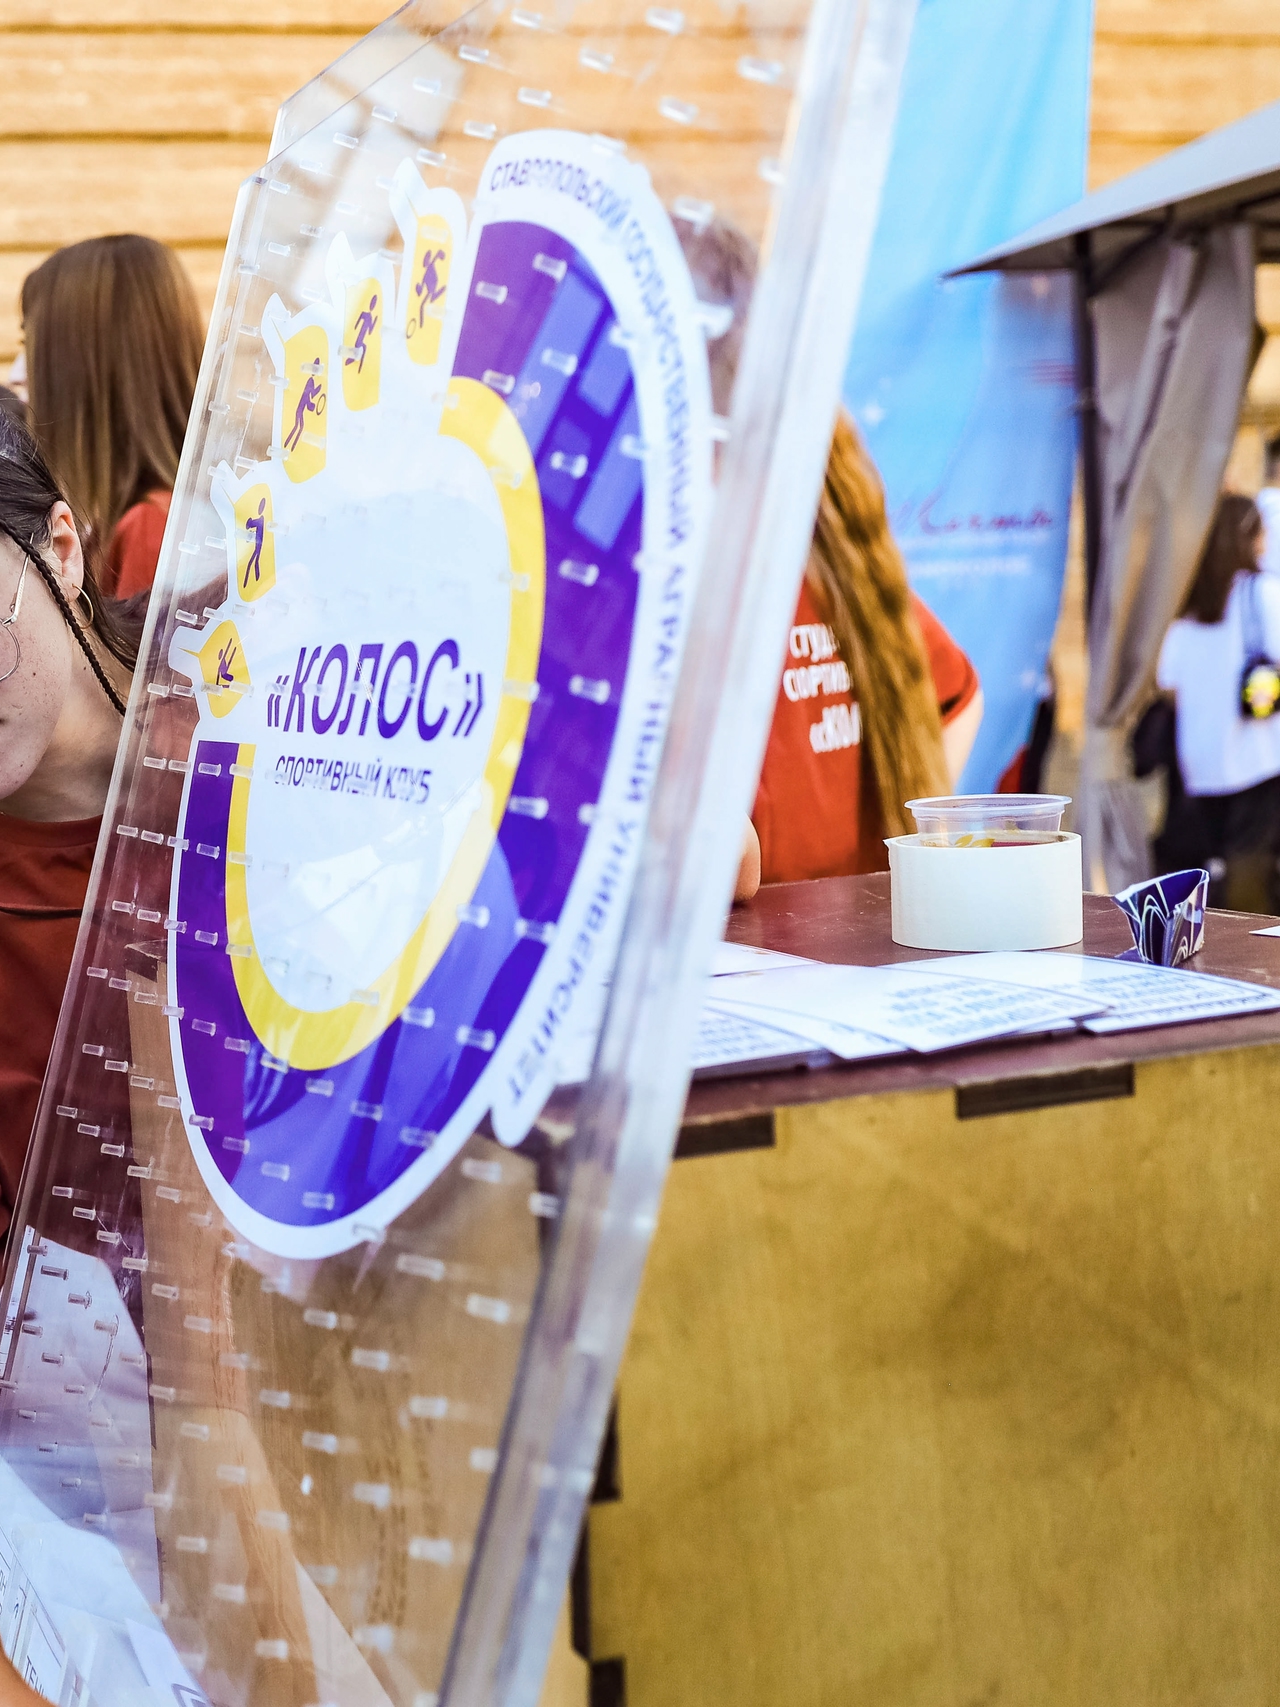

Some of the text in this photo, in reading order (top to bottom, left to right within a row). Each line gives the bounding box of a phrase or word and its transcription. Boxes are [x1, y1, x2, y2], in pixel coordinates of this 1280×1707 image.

[266, 638, 484, 742] «КОЛОС»
[273, 754, 434, 804] СПОРТИВНЫЙ КЛУБ
